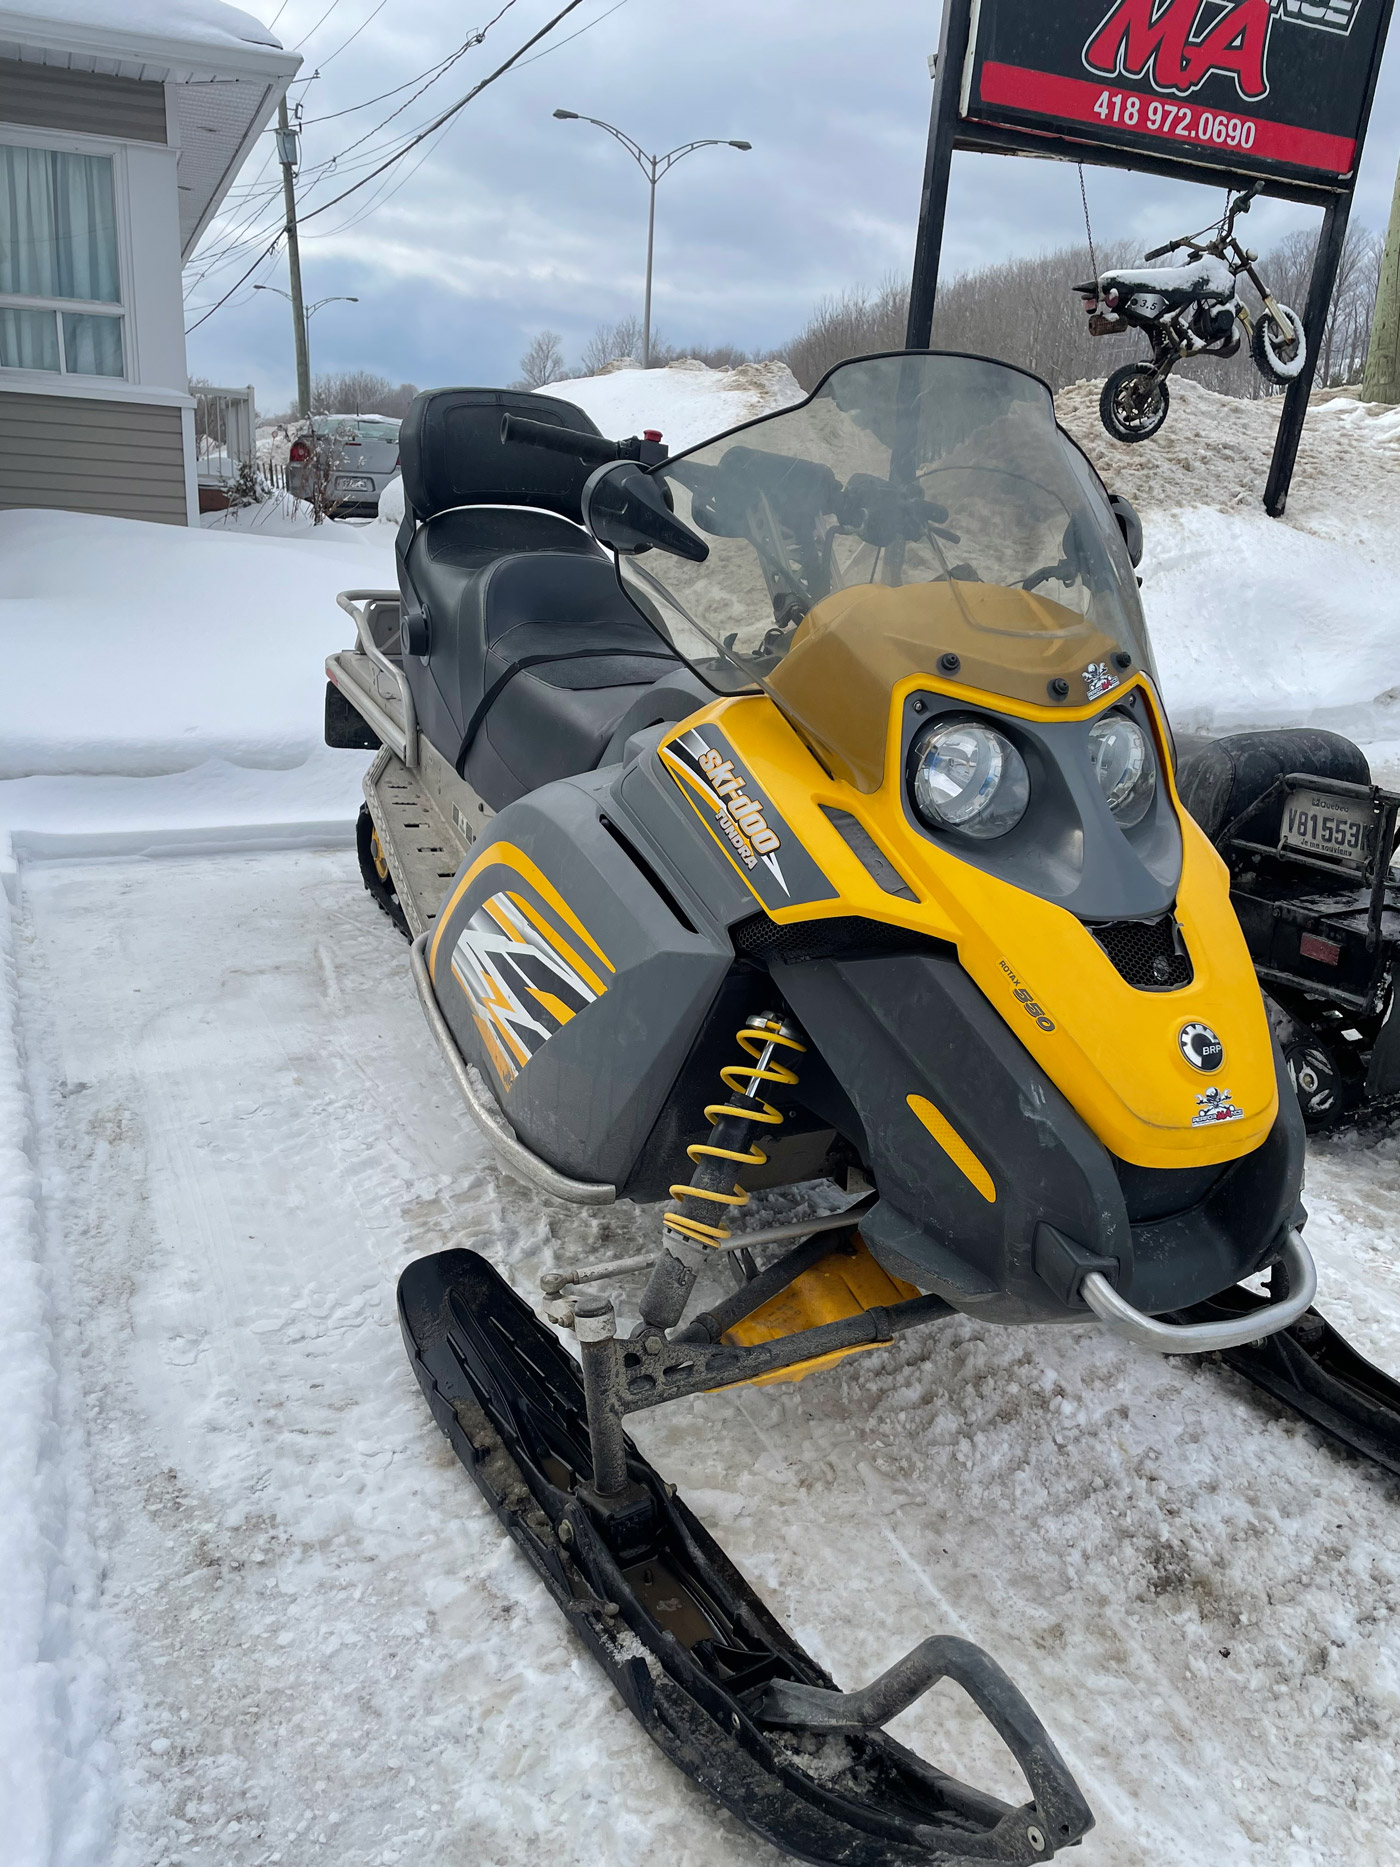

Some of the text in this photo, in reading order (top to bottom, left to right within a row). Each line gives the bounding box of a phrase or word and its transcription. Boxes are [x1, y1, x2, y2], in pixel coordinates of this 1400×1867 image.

[1093, 91, 1256, 149] 418 972.0690
[1139, 299, 1158, 311] 3.5
[715, 809, 758, 871] TUNDRA
[999, 960, 1056, 1032] ROTAX 550
[1202, 1044, 1222, 1056] BRP
